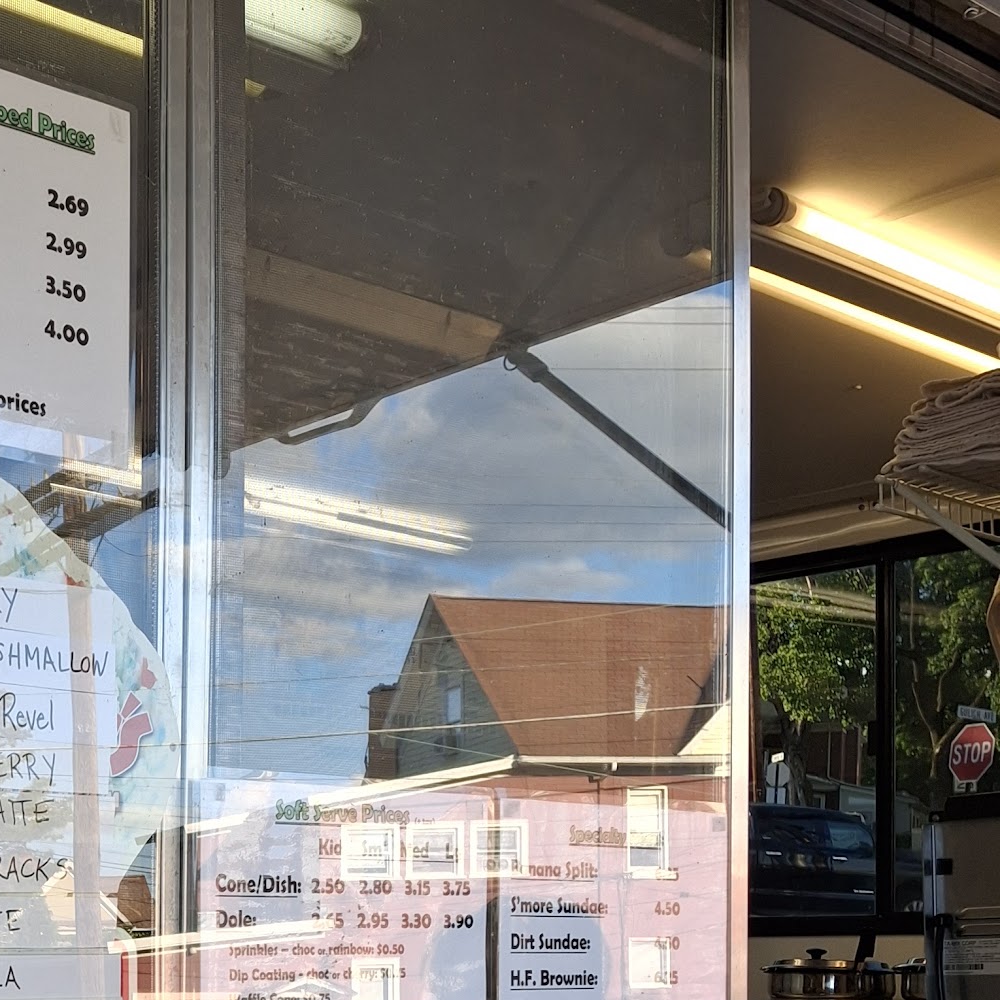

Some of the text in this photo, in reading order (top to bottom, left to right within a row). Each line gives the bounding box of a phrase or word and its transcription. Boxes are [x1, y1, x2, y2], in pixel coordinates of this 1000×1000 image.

[38, 112, 95, 151] Prices
[47, 188, 90, 217] 2.69
[45, 232, 87, 260] 2.99
[45, 275, 87, 303] 3.50
[44, 319, 90, 347] 4.00
[952, 740, 992, 766] STOP
[275, 798, 310, 822] Soft
[361, 803, 410, 826] Prices
[214, 873, 471, 897] Cone/Dish: 2.50 2.80 3.15 3.75
[510, 895, 681, 916] S'more Sundae: 4.50
[216, 909, 474, 930] Dole: 2.95 3.30 3.90
[510, 932, 591, 951] Dirt Sundae:
[510, 969, 599, 987] H.F. Brownie:
